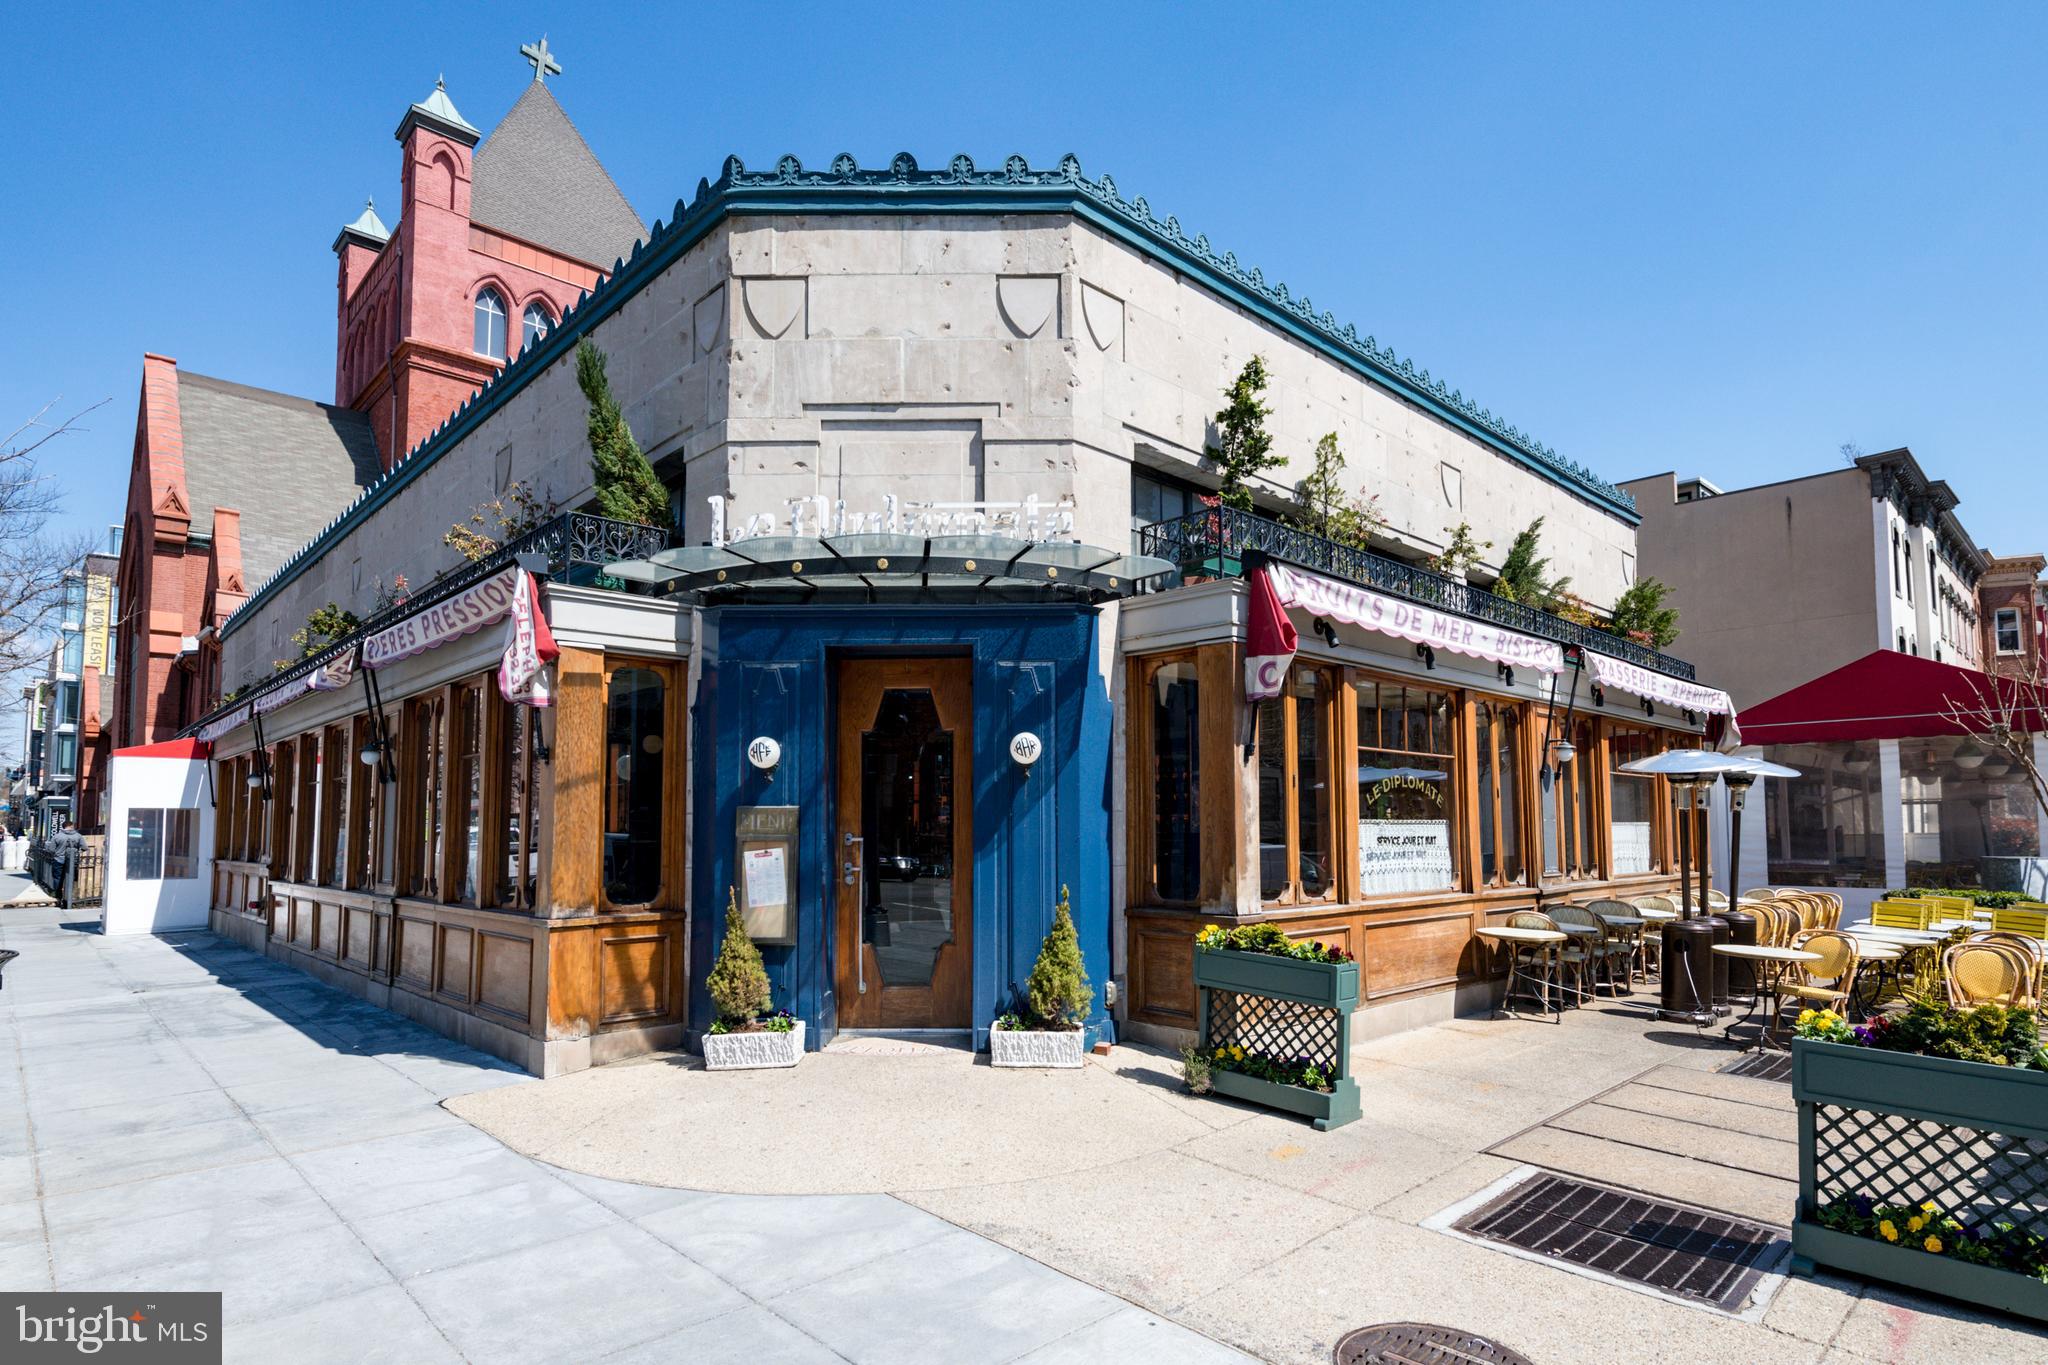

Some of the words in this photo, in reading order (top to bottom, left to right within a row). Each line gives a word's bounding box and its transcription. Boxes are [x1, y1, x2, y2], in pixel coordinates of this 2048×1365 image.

[91, 608, 105, 633] NOW
[421, 572, 516, 640] PRESSION
[1395, 603, 1423, 631] DE
[1432, 614, 1475, 646] MER
[1495, 631, 1556, 662] BISTRO
[1366, 784, 1381, 805] LE
[1383, 775, 1444, 808] DIPLOMATE
